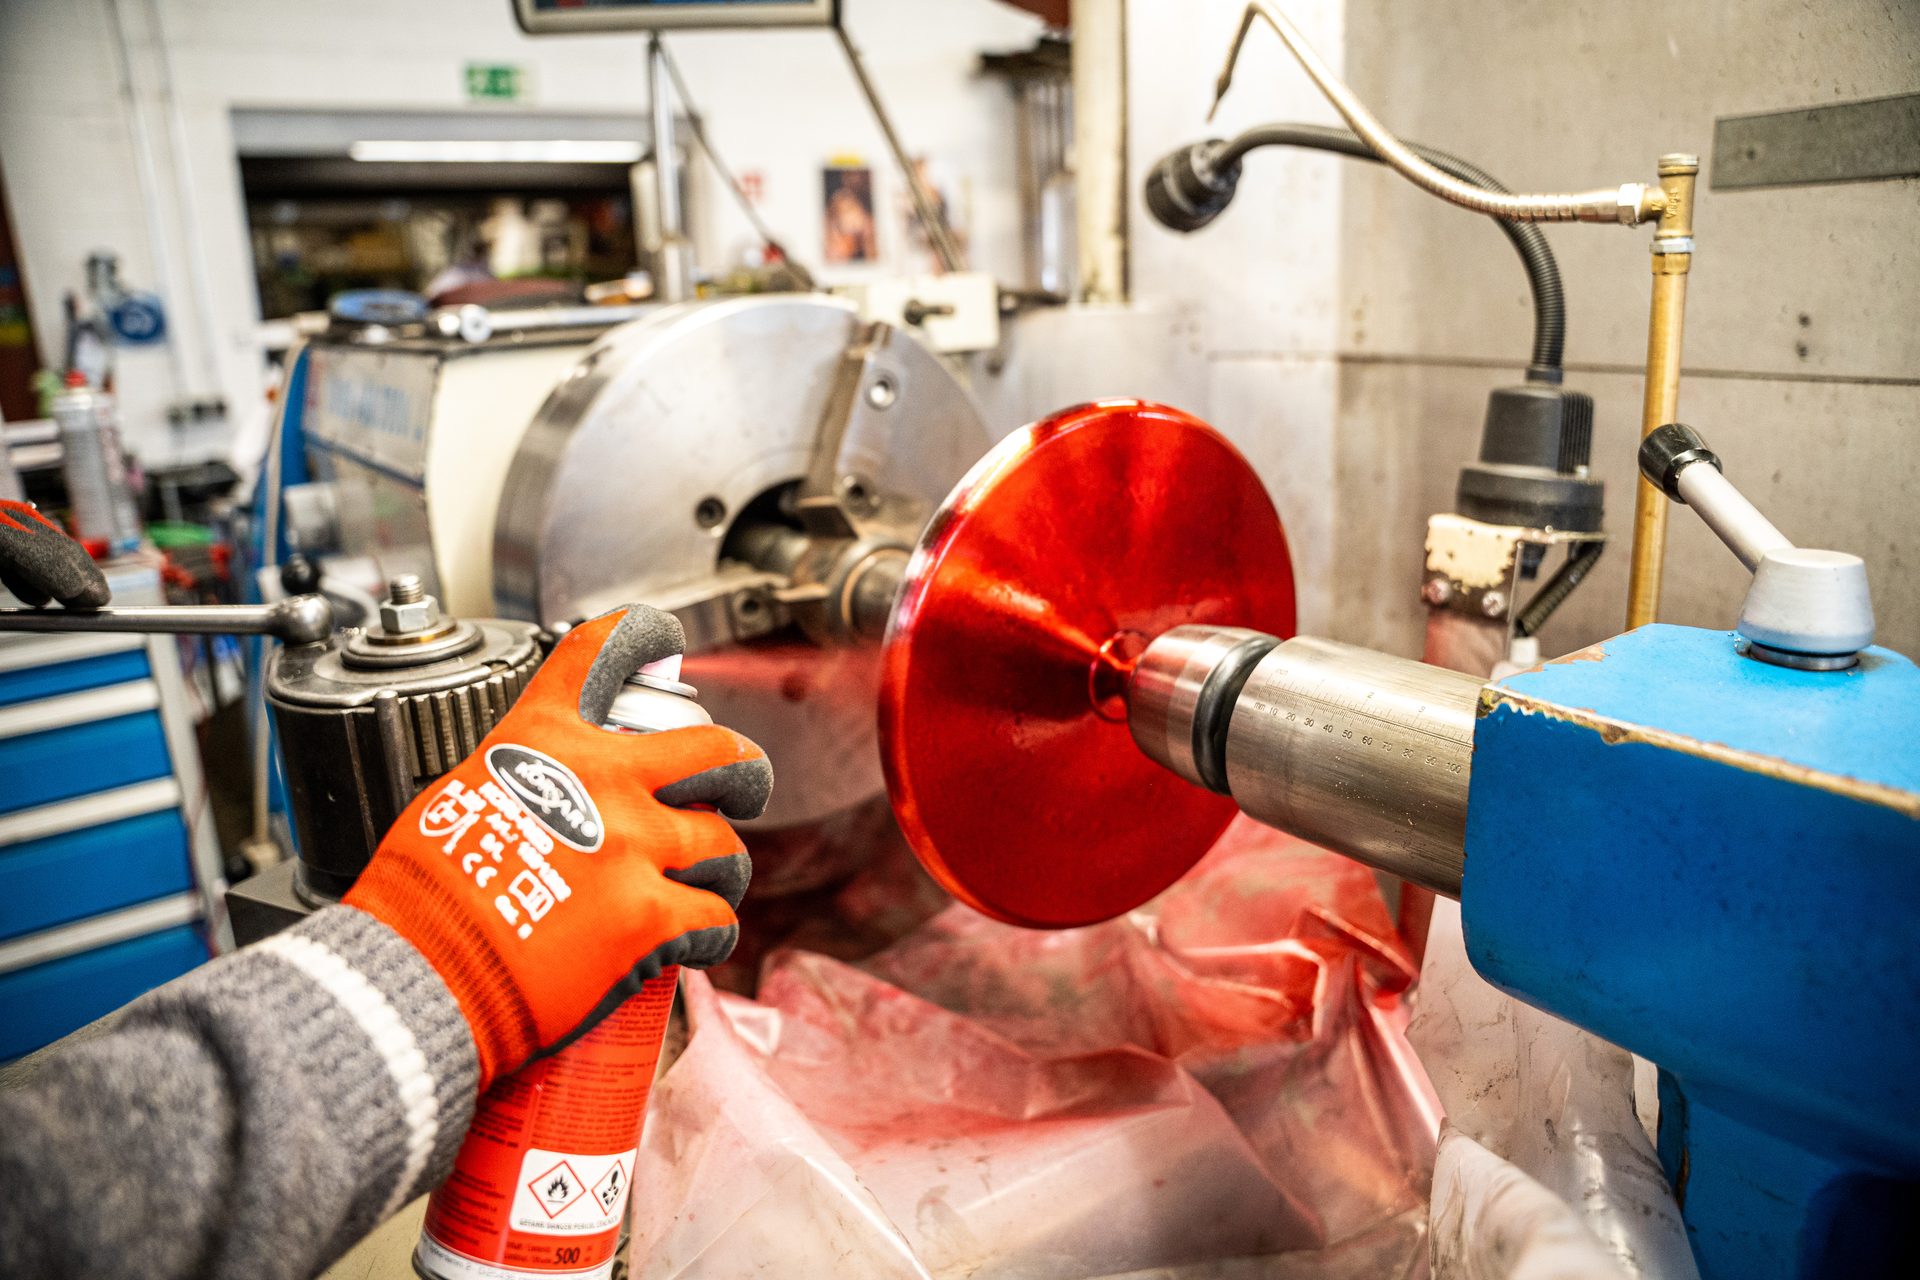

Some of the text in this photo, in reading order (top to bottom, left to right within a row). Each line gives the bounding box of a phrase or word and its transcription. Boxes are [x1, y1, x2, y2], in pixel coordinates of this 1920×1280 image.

[1269, 706, 1279, 717] 10
[1286, 711, 1296, 722] 20
[1303, 717, 1315, 728] 30
[1322, 723, 1334, 734] 40
[1341, 729, 1353, 740] 50
[1361, 735, 1373, 746] 60
[1382, 741, 1393, 752] 70
[1402, 748, 1414, 759] 80
[1424, 755, 1437, 766] 90
[1445, 762, 1462, 774] 100
[553, 1247, 581, 1264] 500
